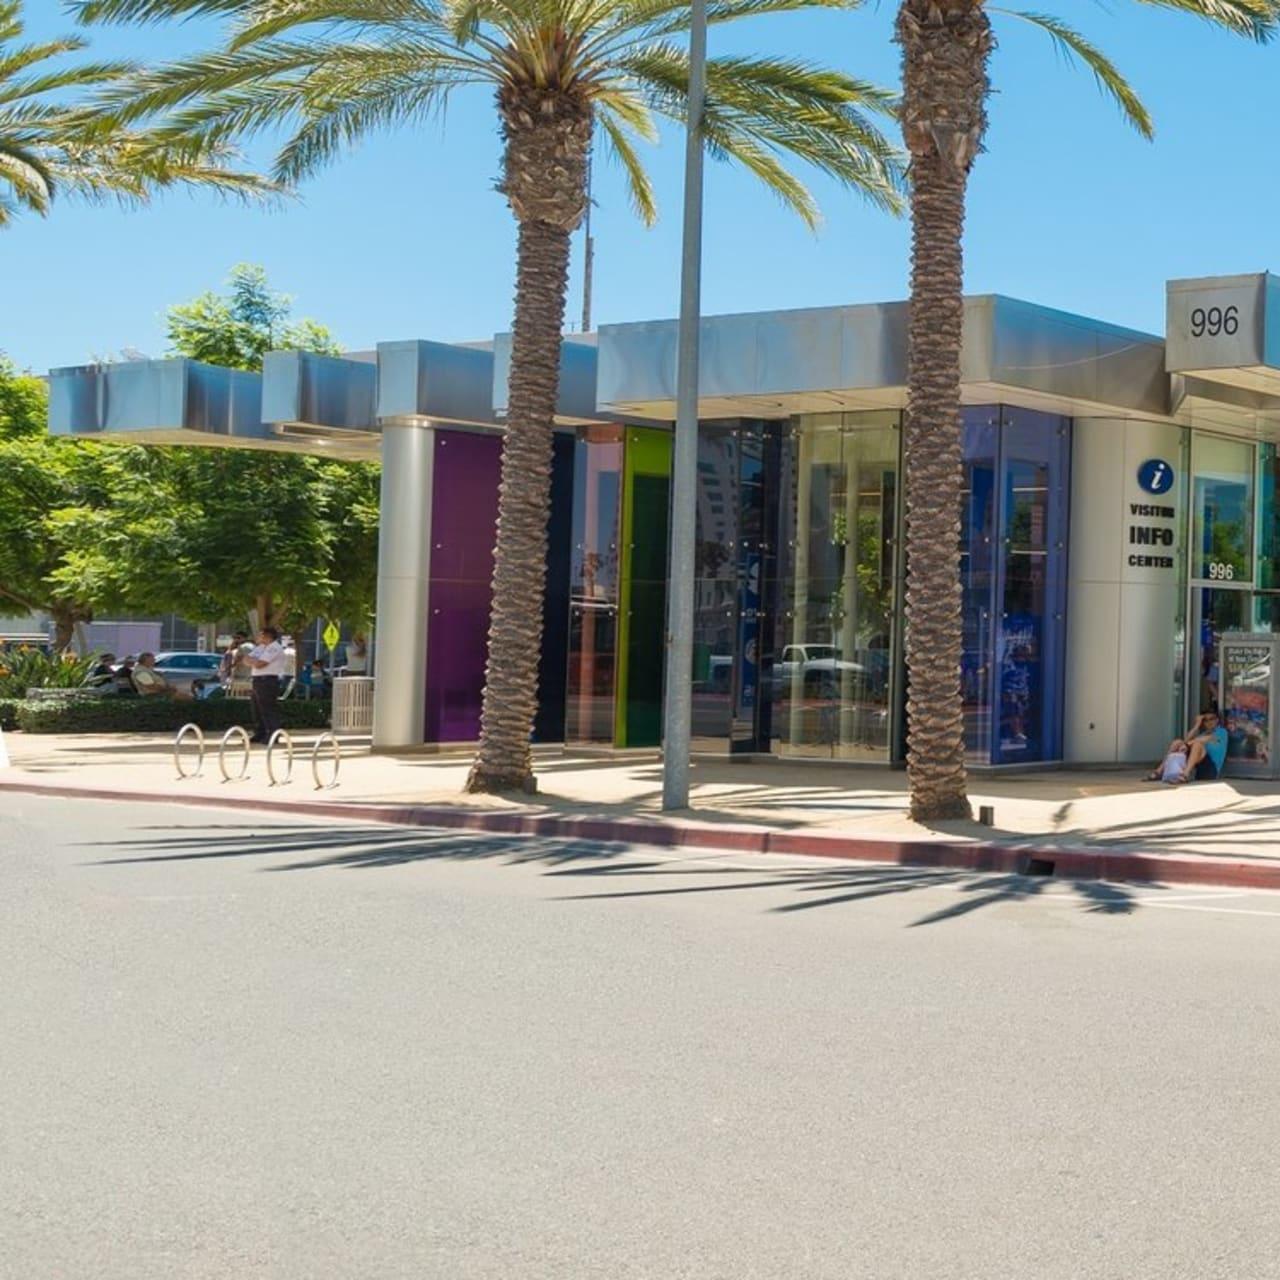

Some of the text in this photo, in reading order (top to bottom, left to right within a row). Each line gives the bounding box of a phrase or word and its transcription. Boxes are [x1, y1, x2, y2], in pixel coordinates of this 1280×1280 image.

[1190, 305, 1239, 337] 996
[1130, 504, 1175, 518] VISITOR
[1129, 526, 1174, 546] INFO
[1128, 554, 1174, 568] CENTER
[1208, 562, 1234, 580] 996
